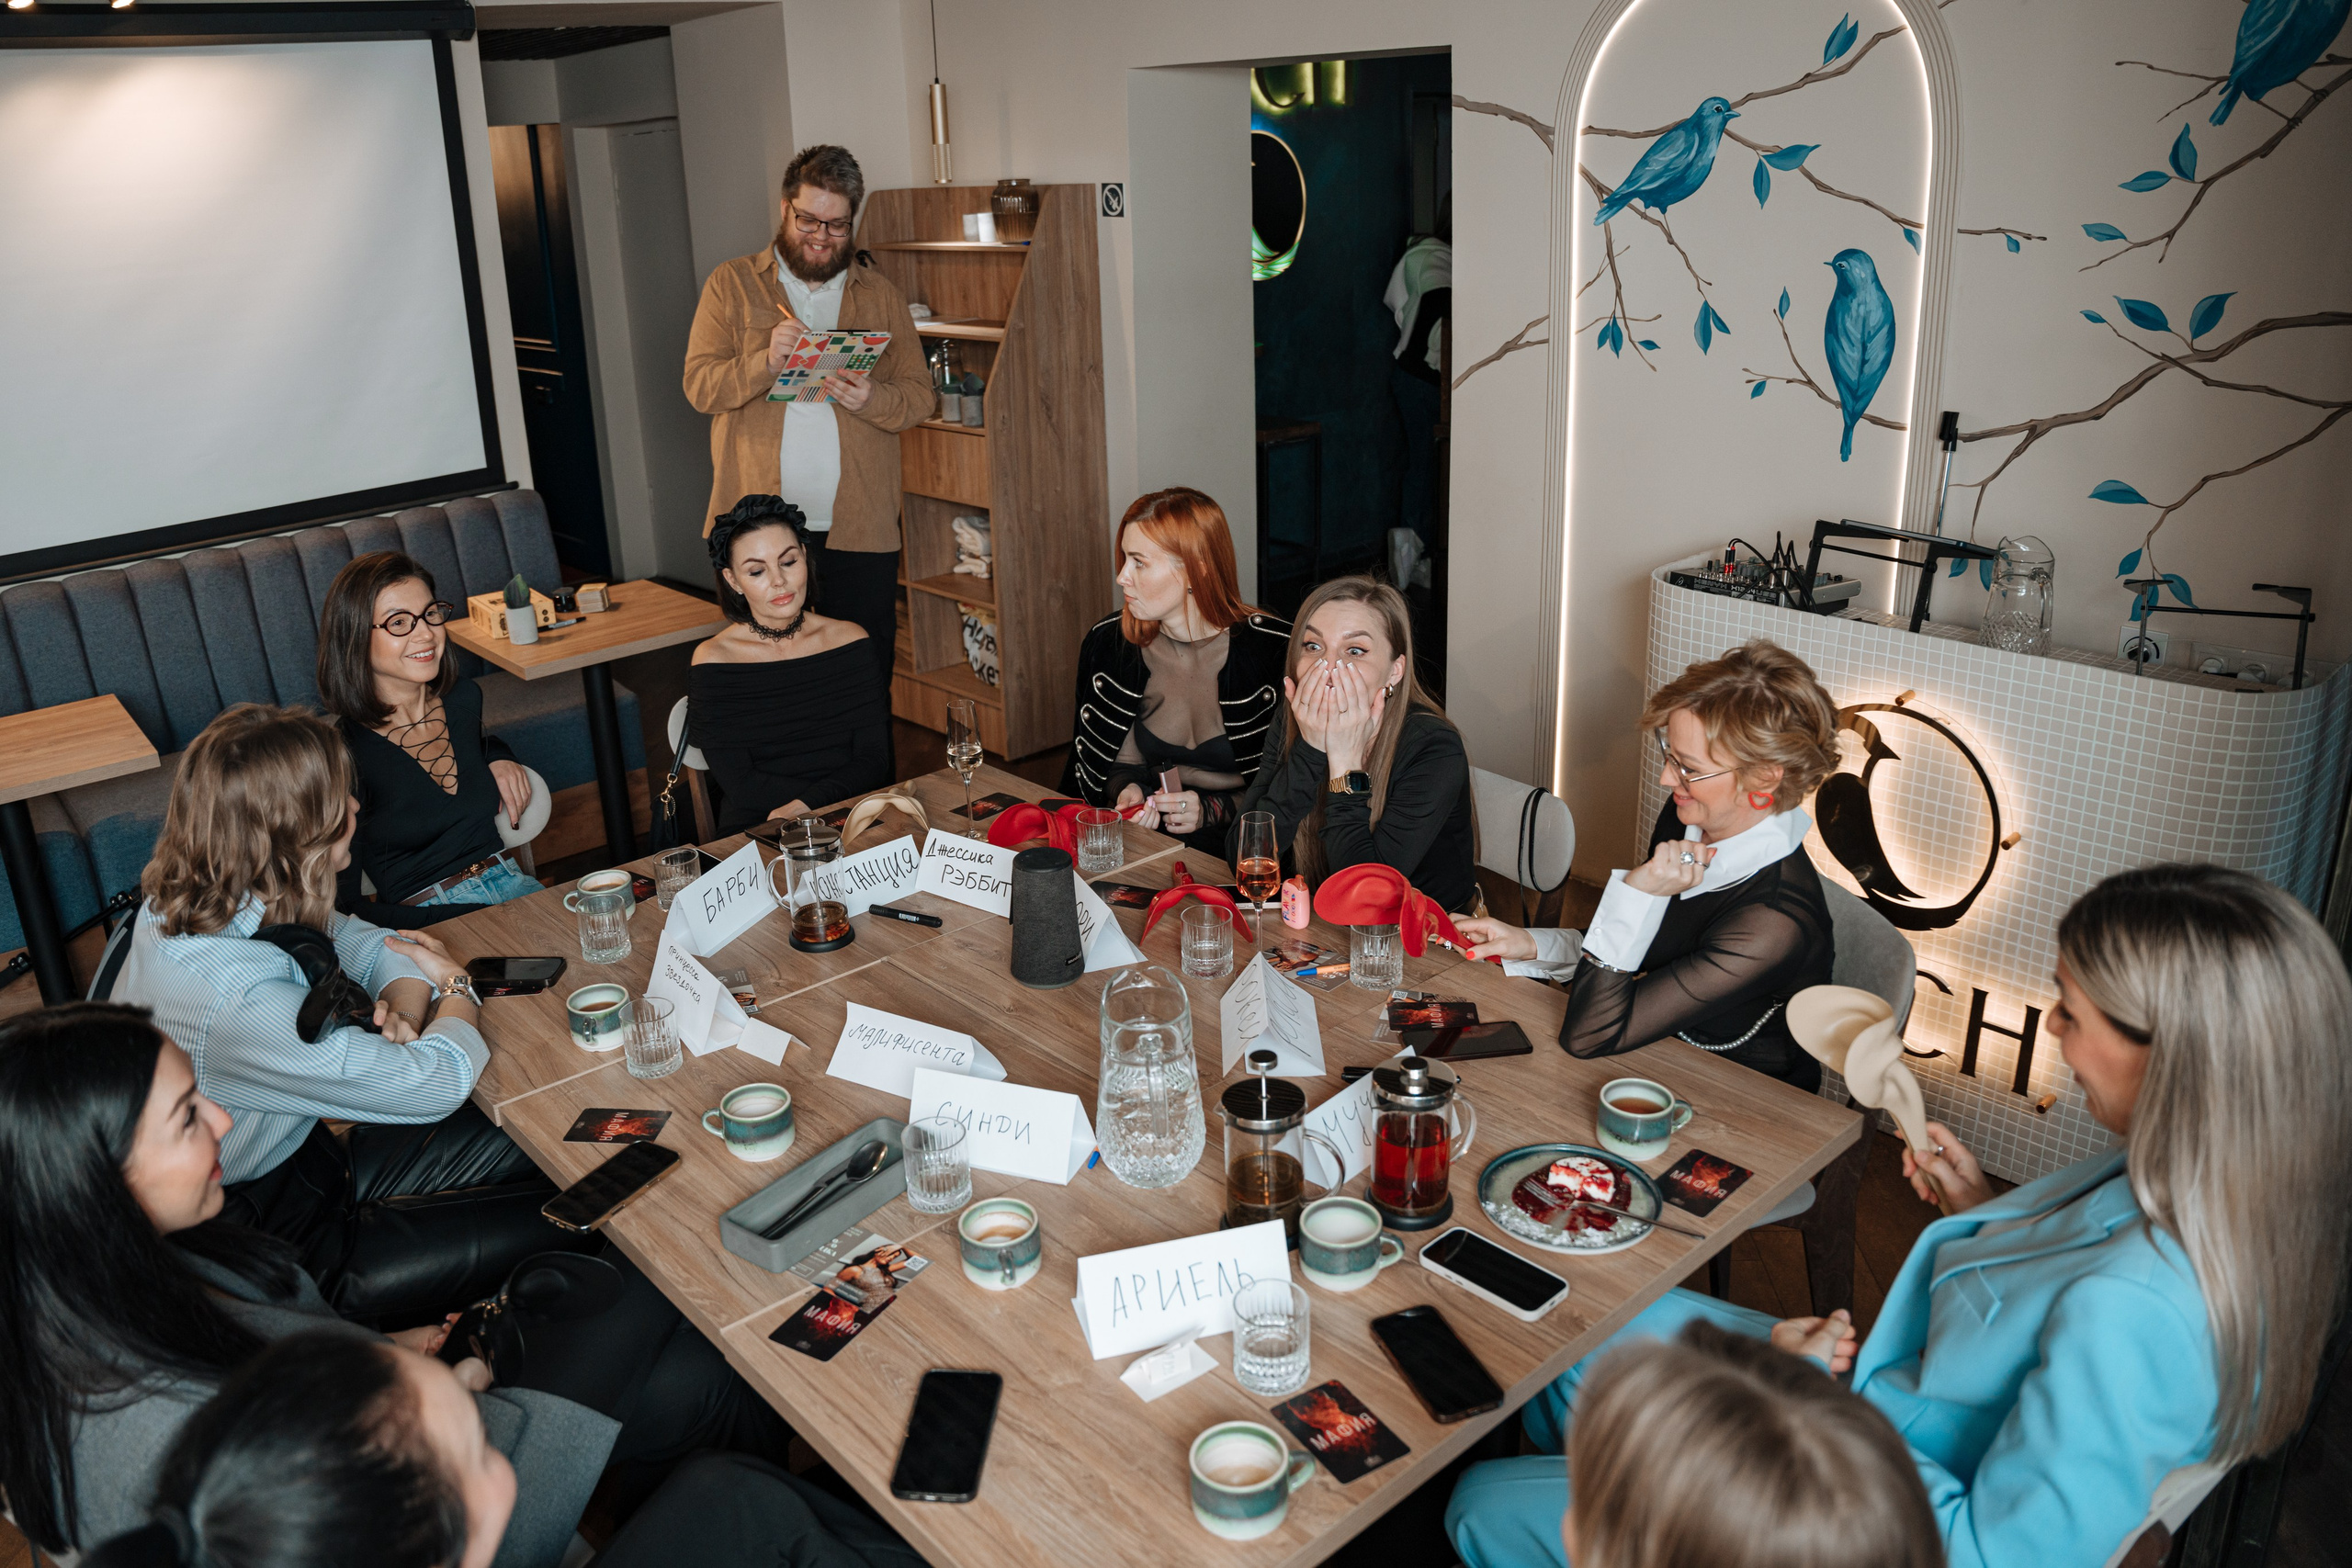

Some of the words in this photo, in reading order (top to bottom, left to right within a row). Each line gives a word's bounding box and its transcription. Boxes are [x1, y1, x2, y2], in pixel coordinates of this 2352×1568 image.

[703, 863, 760, 924] БАРБИ
[941, 863, 1012, 897] РЭББИТ
[599, 1111, 629, 1142] МАФИЯ
[934, 1100, 1031, 1145] СИНДИ
[1669, 1169, 1727, 1199] МАФИЯ
[1112, 1258, 1256, 1328] АРИЕЛЬ
[803, 1304, 862, 1335] МАФИЯ
[1309, 1412, 1377, 1451] МАФИЯ
